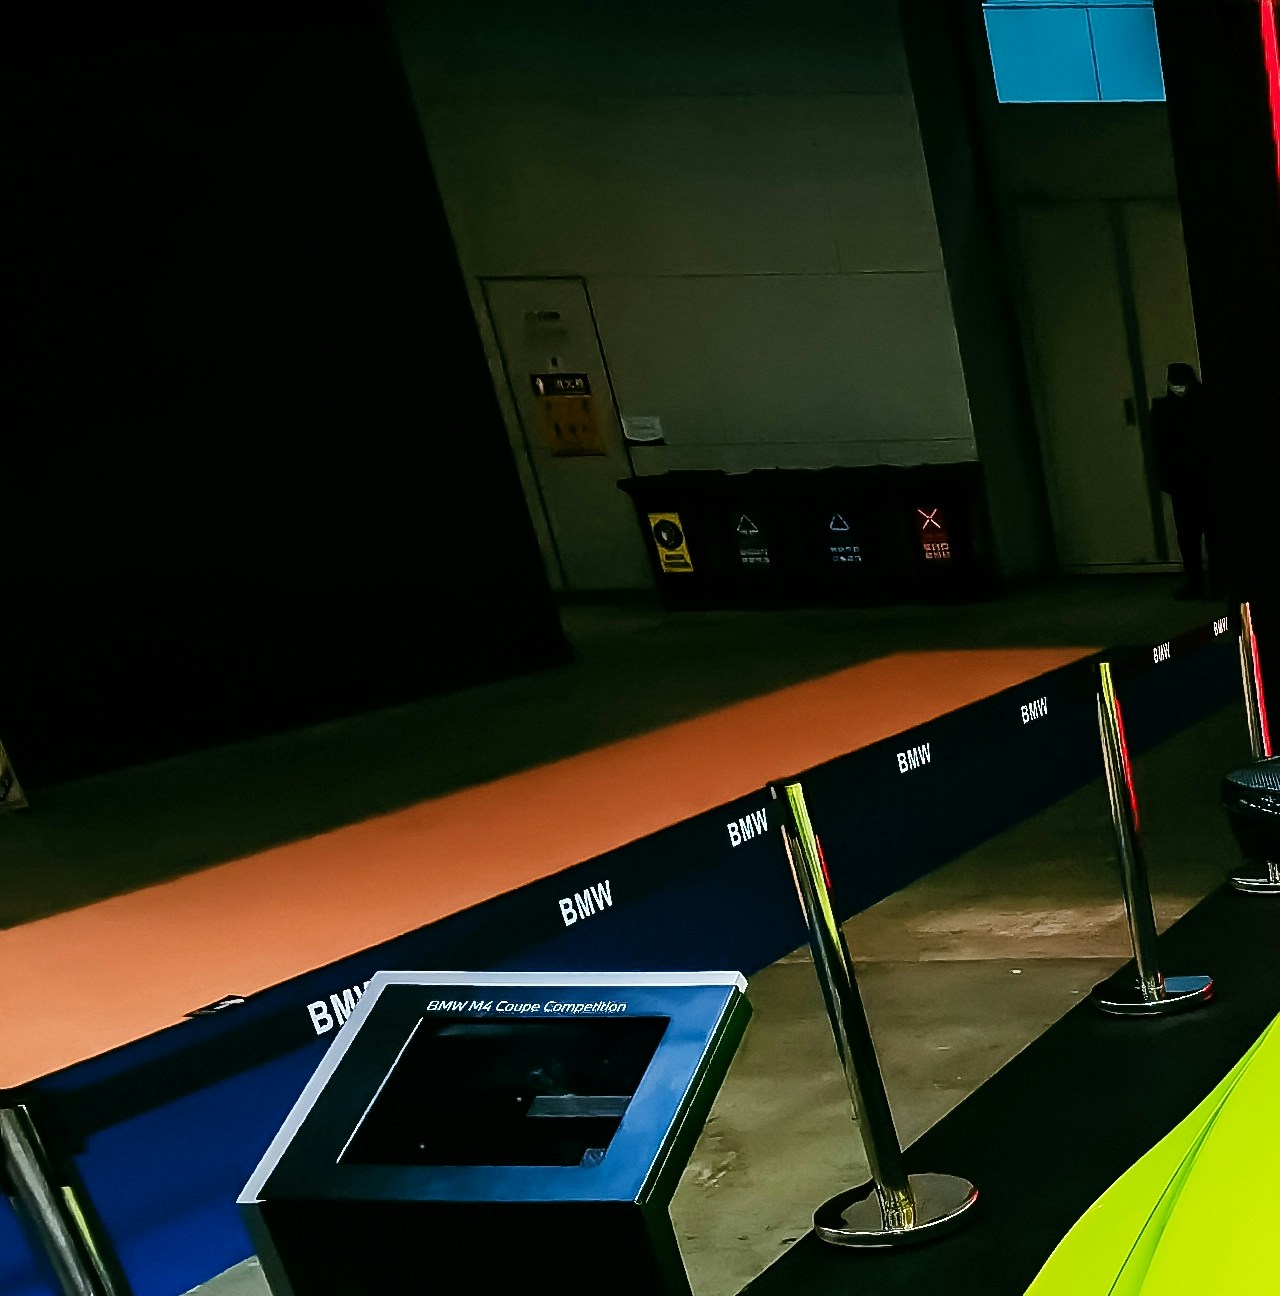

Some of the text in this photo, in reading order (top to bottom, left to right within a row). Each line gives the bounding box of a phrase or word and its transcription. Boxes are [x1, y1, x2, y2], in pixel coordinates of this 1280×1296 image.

[1020, 696, 1048, 725] BMW
[896, 742, 931, 774] BMW
[726, 807, 768, 848] BMW
[558, 879, 613, 927] BMW
[426, 1000, 627, 1014] BMW M4 Coupe Competition
